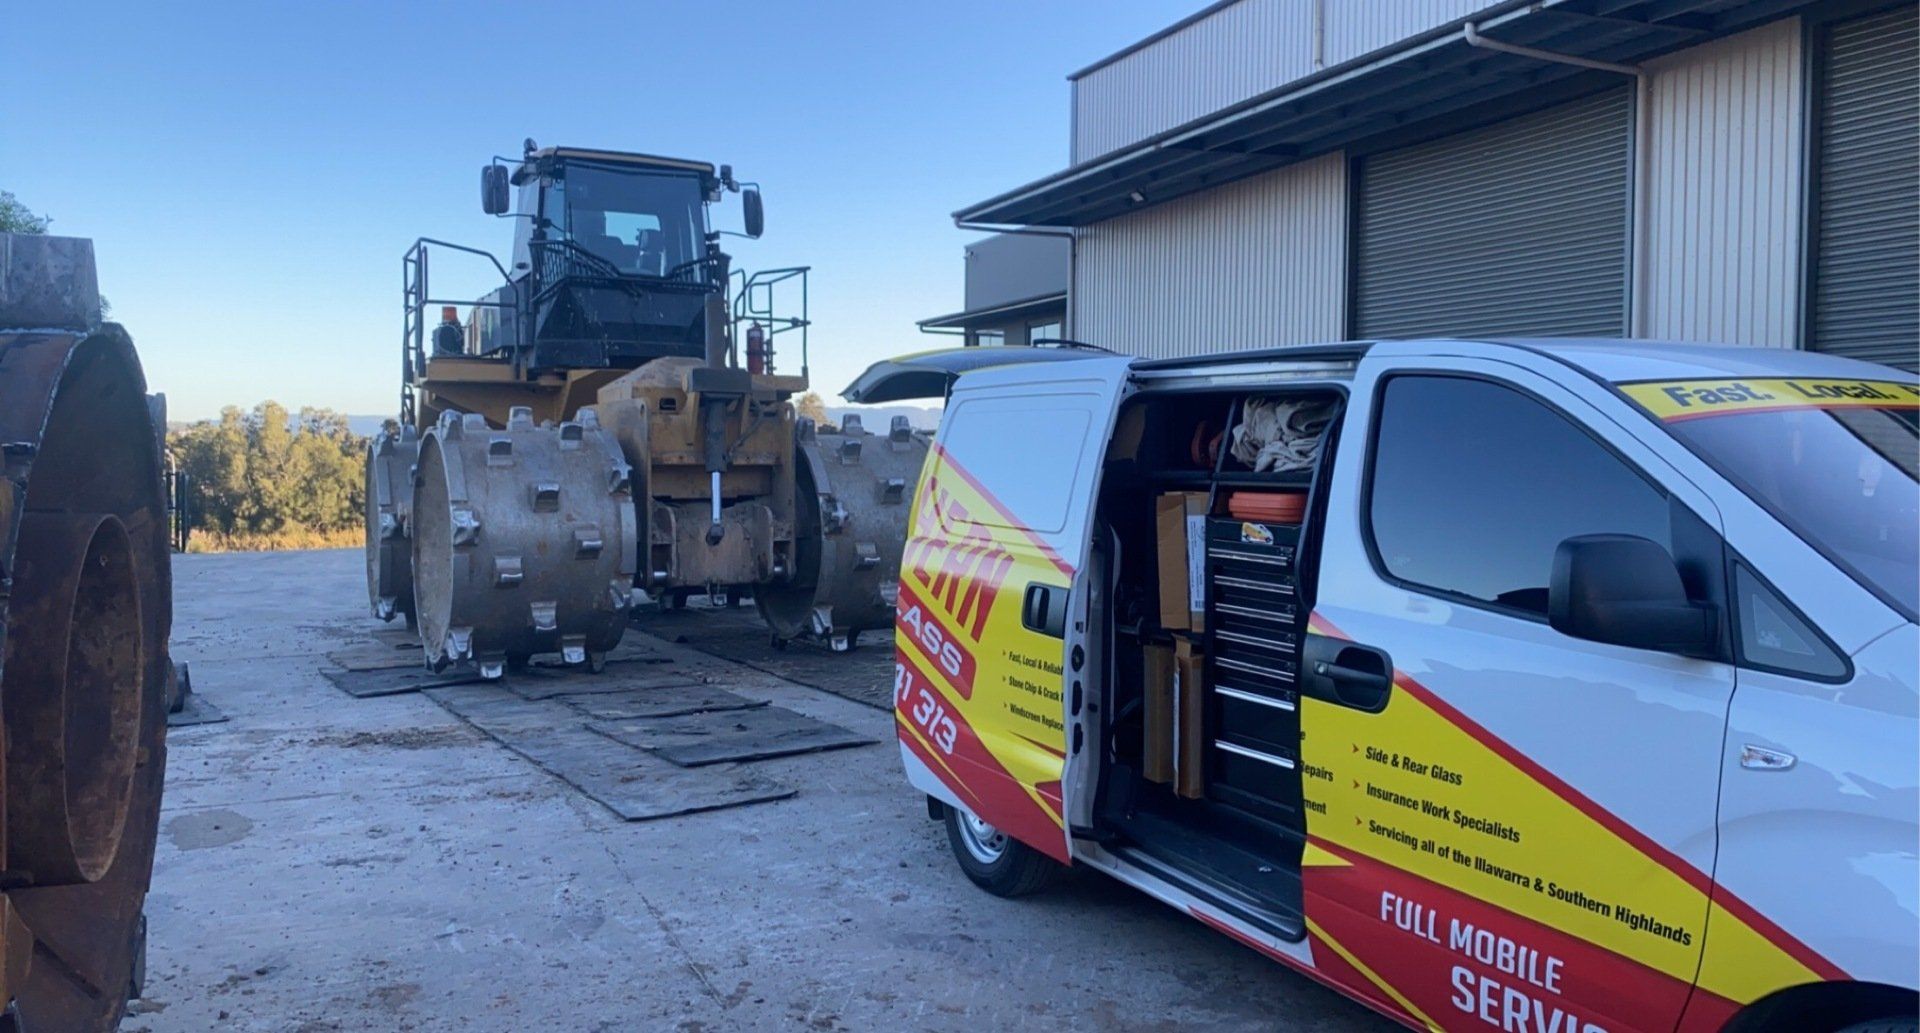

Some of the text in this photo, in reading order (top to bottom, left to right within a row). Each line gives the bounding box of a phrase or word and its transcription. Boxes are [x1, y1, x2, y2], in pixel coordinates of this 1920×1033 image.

[1661, 382, 1774, 407] Fast.
[1785, 381, 1898, 400] Local.
[1022, 655, 1037, 668] Local
[1037, 659, 1042, 670] &
[1009, 676, 1023, 690] Stone
[1024, 681, 1037, 696] Chip
[1037, 685, 1042, 696] &
[1043, 687, 1059, 701] Crack
[1010, 703, 1040, 723] Windscreen
[913, 689, 957, 754] 313
[1365, 746, 1463, 786] Side & Rear Glass
[1366, 782, 1520, 843] Insurance Work Specialists
[1369, 820, 1692, 946] Servicing all of the Illawarra & Southern Highlands
[1380, 890, 1564, 995] FULL MOBILE
[1451, 965, 1608, 1033] SERV
